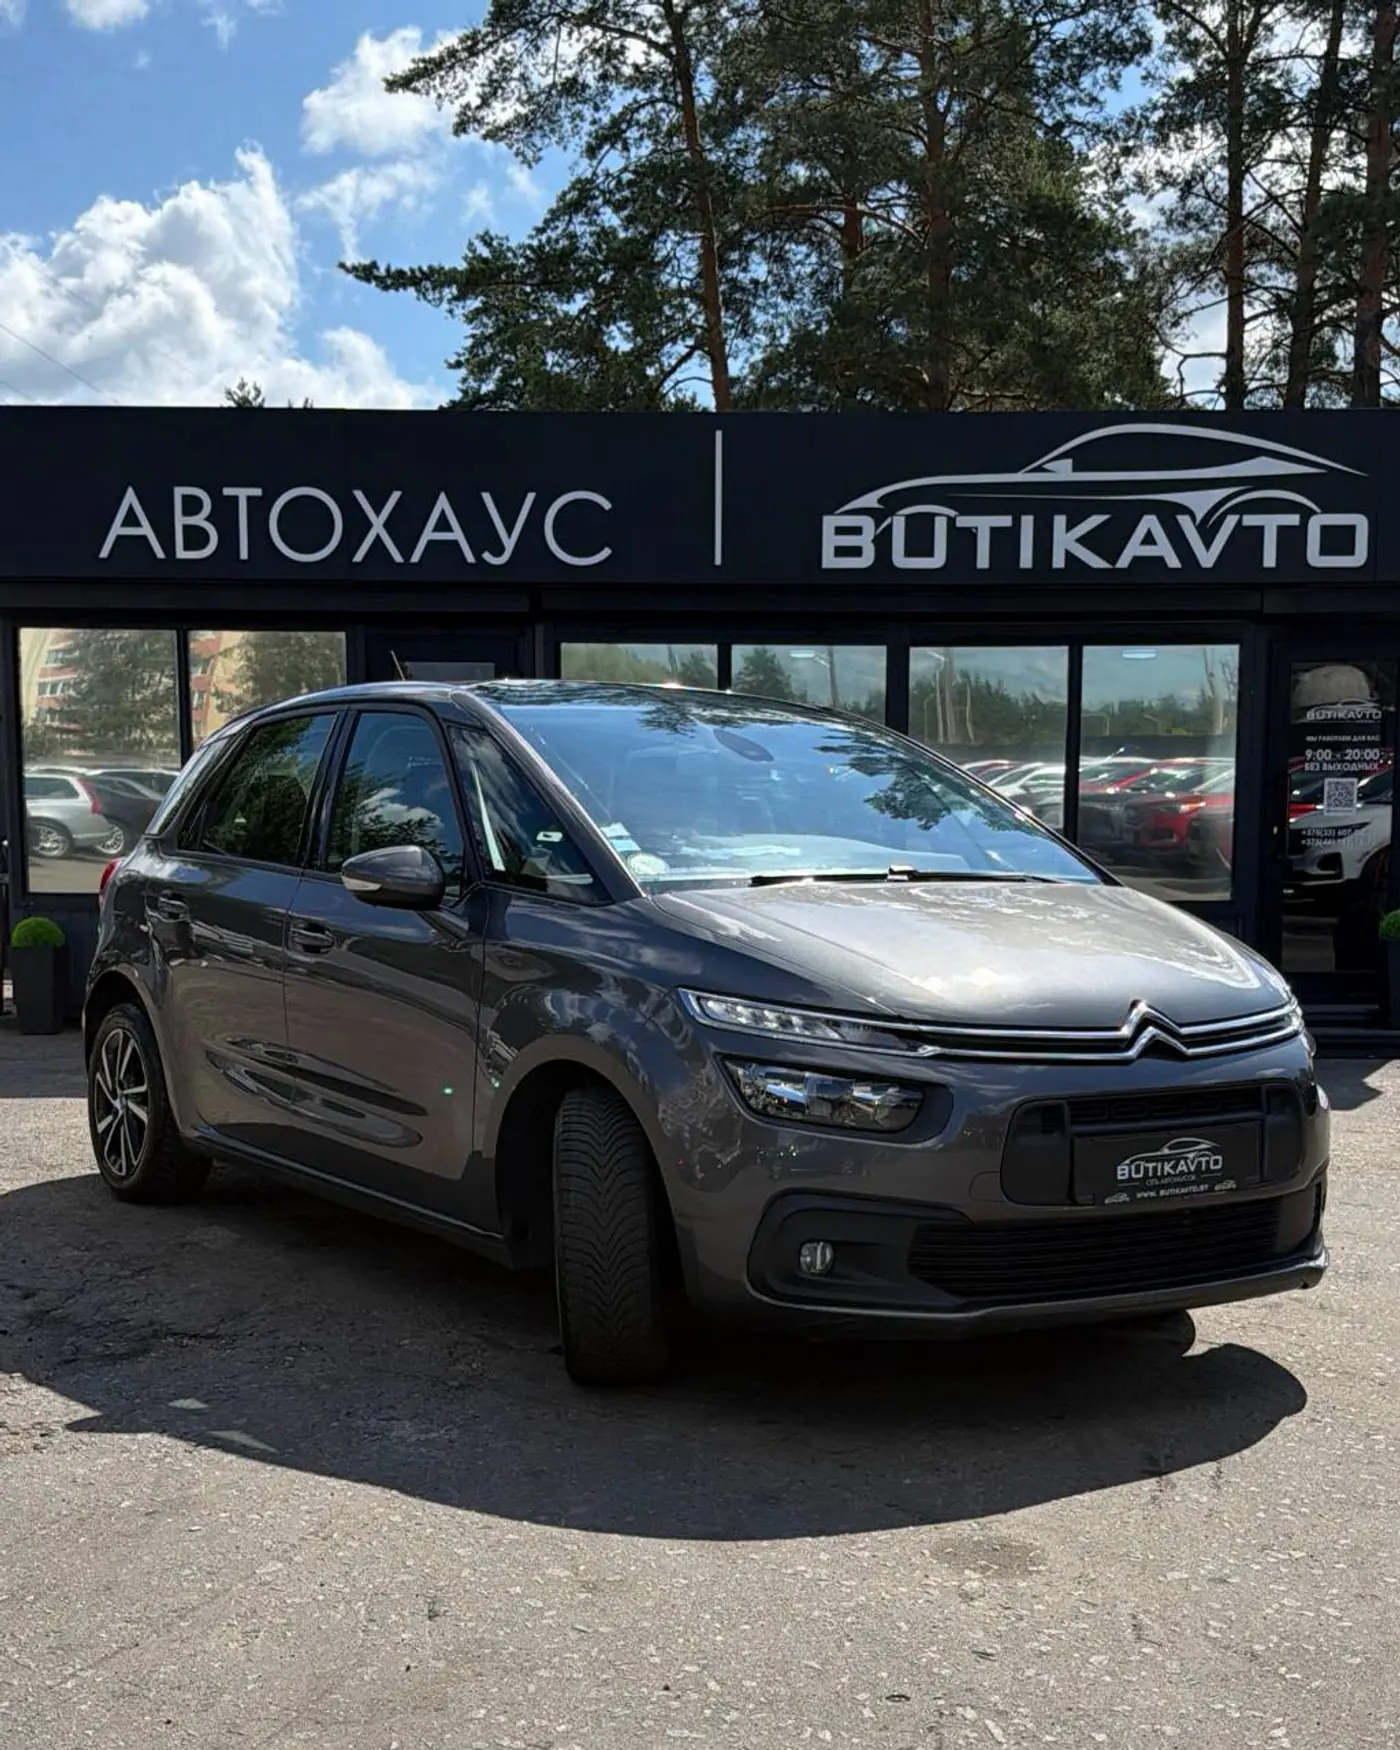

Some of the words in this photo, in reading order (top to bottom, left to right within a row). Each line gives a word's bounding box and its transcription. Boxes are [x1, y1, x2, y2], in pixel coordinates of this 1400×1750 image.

[98, 485, 612, 567] АВТОХАУС
[821, 513, 1369, 569] BUTIKAVTO
[1306, 709, 1382, 720] BUTIKAVTO
[1305, 748, 1332, 761] 9:00
[1344, 748, 1380, 761] 20:00
[1304, 762, 1320, 771] БЕЗ
[1322, 762, 1379, 771] ВЫХОДНЫХ
[1117, 1155, 1223, 1180] BUTIKAVTO
